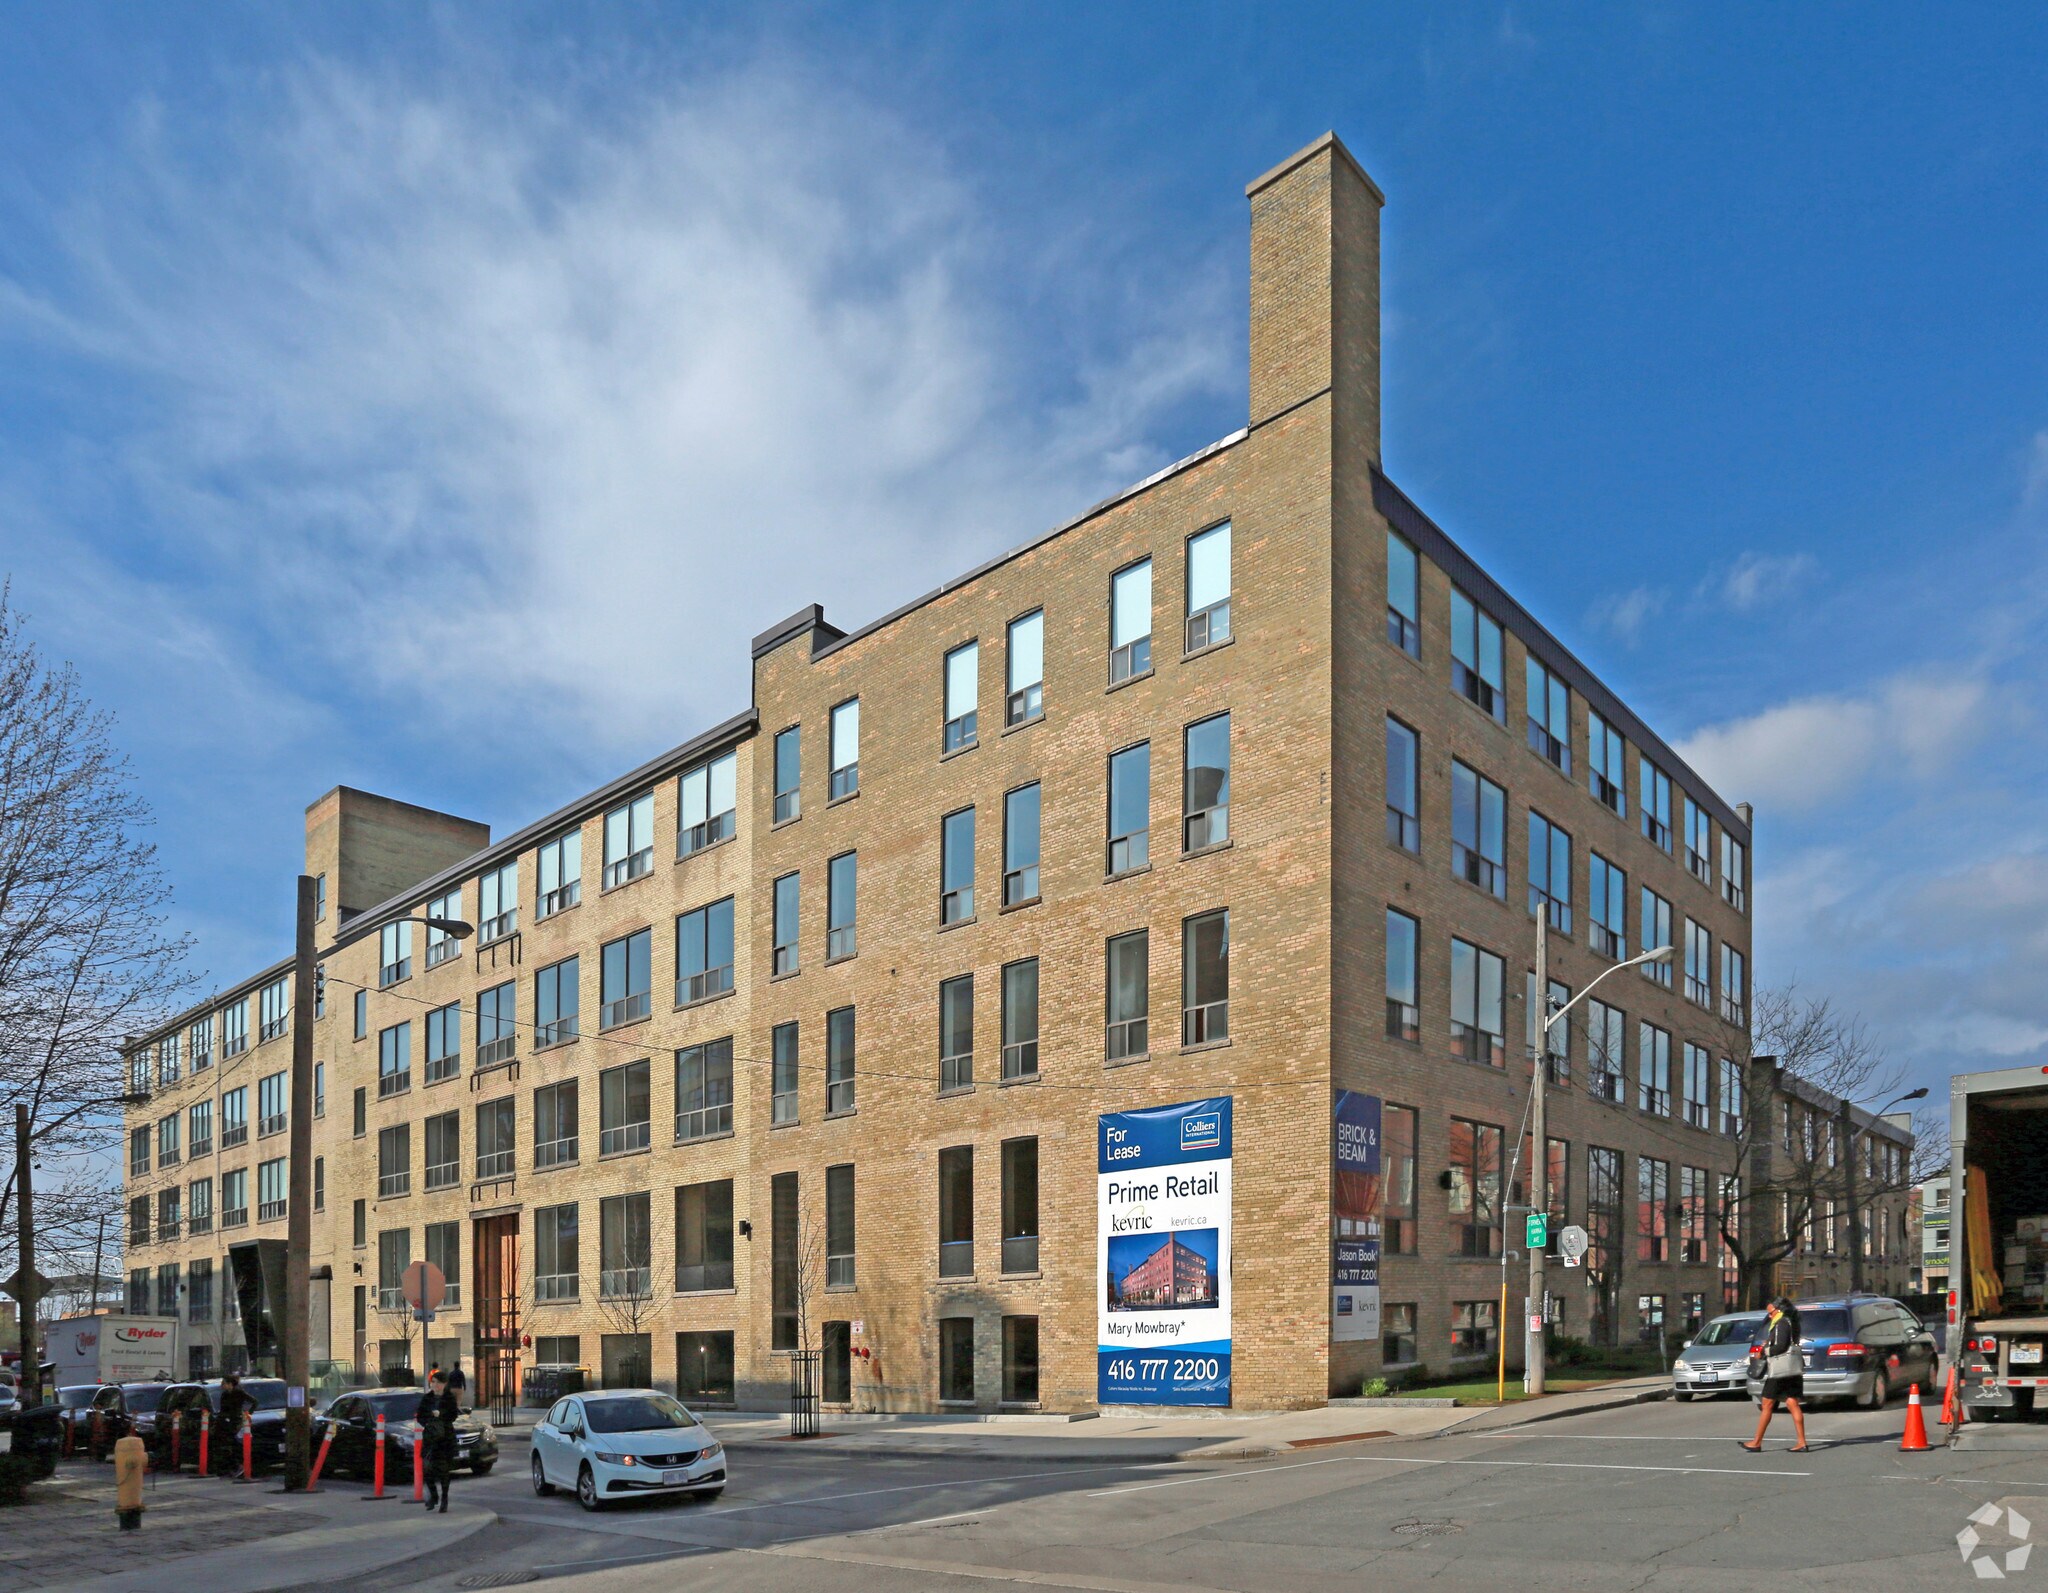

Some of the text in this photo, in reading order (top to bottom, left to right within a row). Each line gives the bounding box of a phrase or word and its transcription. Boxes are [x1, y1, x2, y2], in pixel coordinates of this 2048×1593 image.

[1185, 1120, 1216, 1133] Colliers
[1338, 1123, 1377, 1146] BRICK &
[1107, 1127, 1128, 1144] For
[1107, 1145, 1141, 1161] Lease
[1338, 1142, 1367, 1163] BEAM
[1108, 1171, 1219, 1205] Prime Retail
[1111, 1213, 1153, 1232] kevric
[1170, 1214, 1208, 1227] kevric.ca
[1337, 1248, 1357, 1261] Jason
[1337, 1269, 1378, 1280] 416 777 2200
[127, 1327, 167, 1340] Ryder
[1107, 1322, 1133, 1338] Mary
[1107, 1358, 1219, 1381] 416 777 2200
